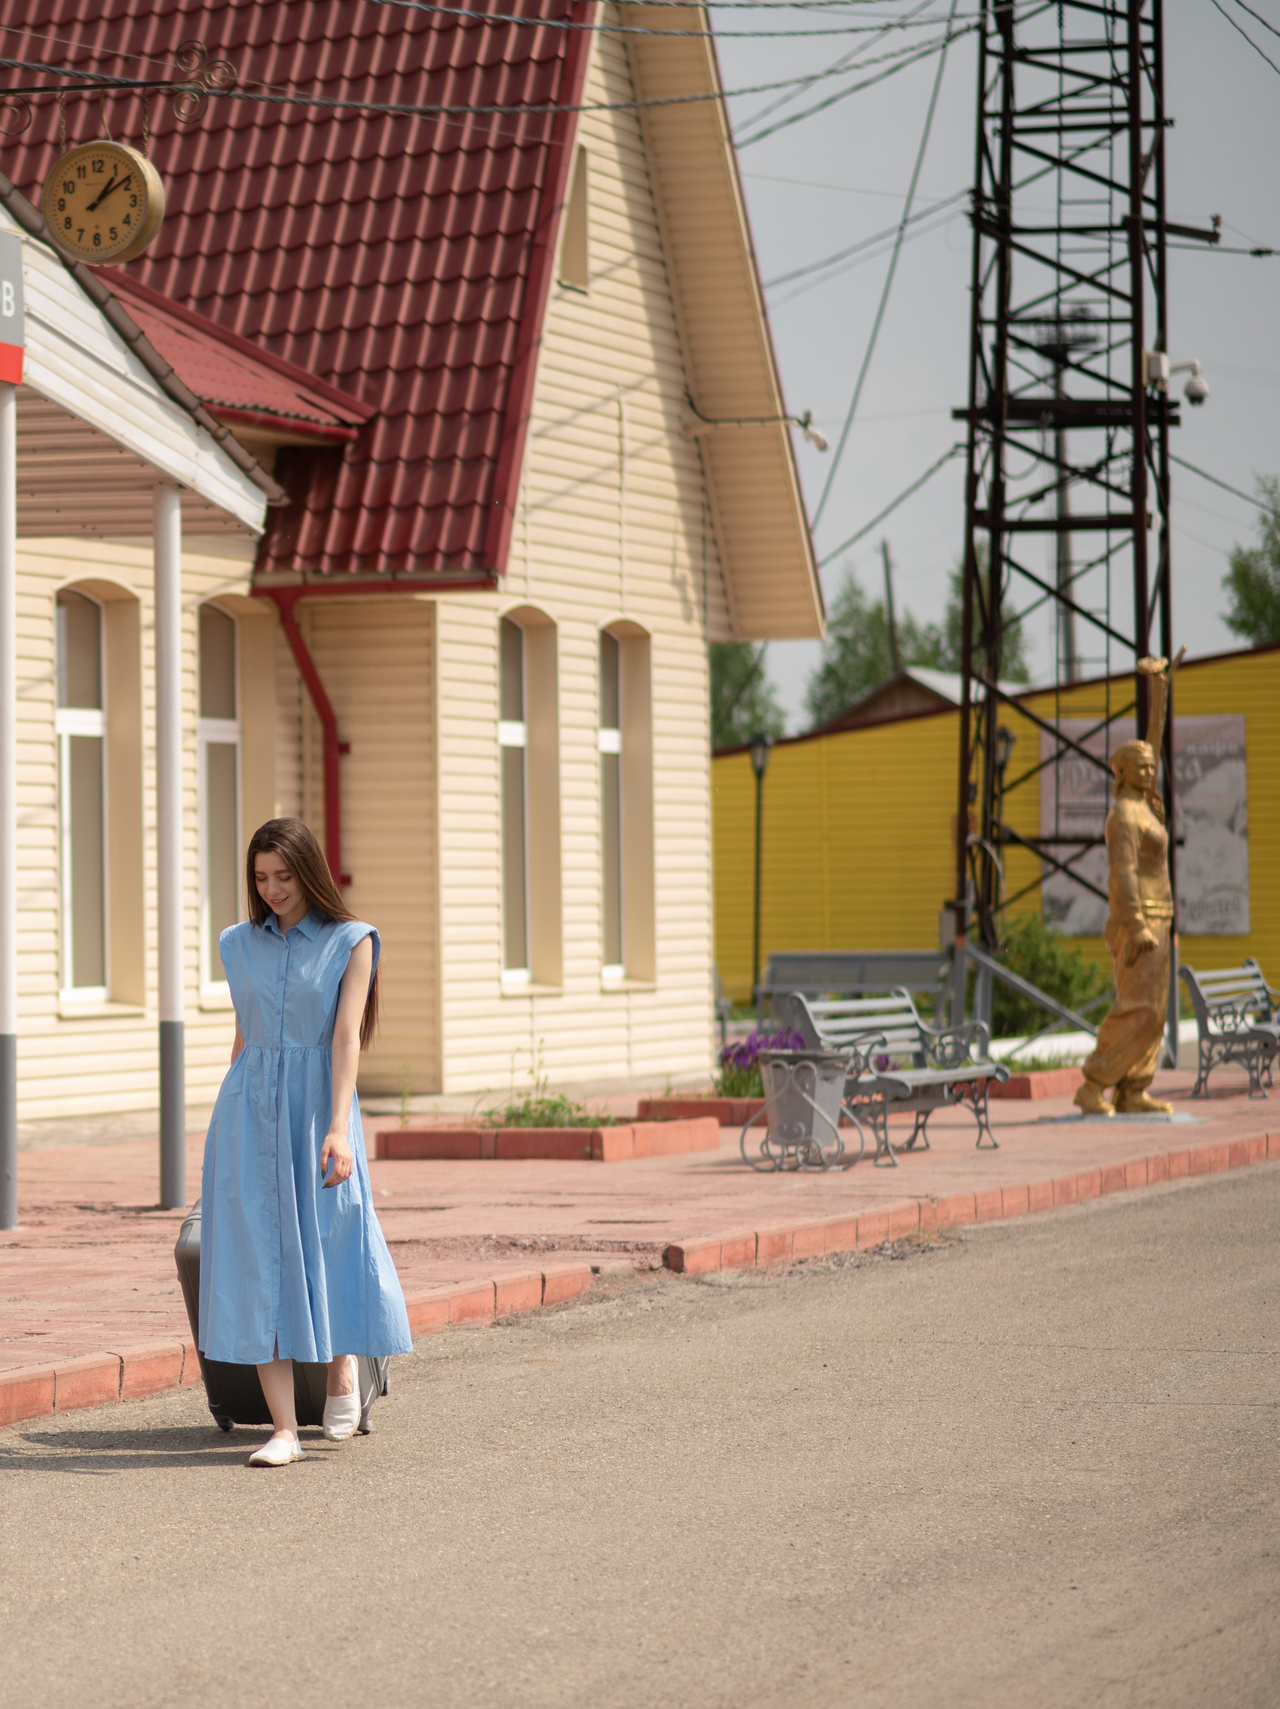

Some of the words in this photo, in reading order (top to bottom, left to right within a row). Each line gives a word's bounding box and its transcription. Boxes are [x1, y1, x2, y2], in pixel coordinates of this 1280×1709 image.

[76, 166, 87, 179] 11
[92, 160, 105, 173] 12
[113, 163, 118, 177] 1
[62, 181, 75, 194] 10
[123, 177, 132, 191] 2
[58, 198, 66, 211] 9
[129, 194, 138, 208] 3
[64, 217, 72, 230] 8
[122, 213, 131, 226] 4
[76, 229, 85, 242] 7
[93, 233, 101, 246] 6
[109, 227, 118, 241] 5
